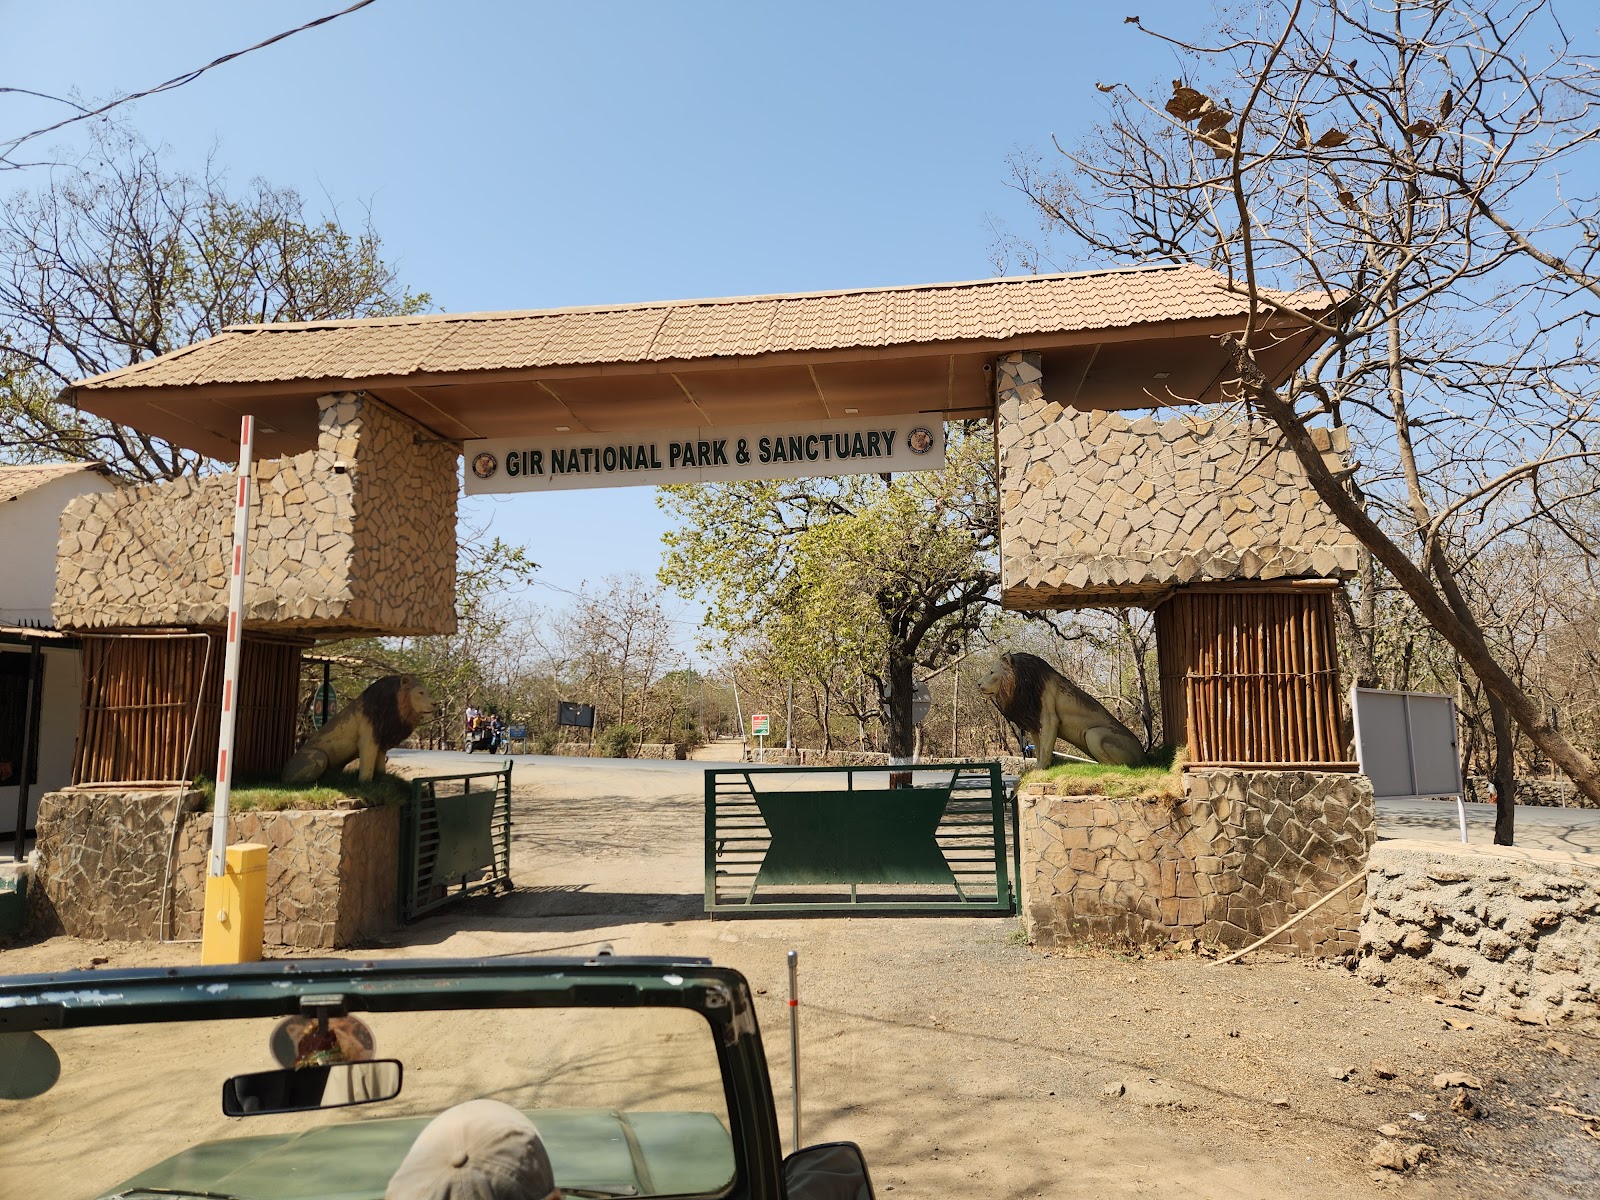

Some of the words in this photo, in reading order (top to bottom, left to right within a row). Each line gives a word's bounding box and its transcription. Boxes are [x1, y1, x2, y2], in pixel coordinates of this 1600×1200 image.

[505, 450, 545, 477] GIR
[550, 444, 663, 475] NATIONAL
[668, 439, 730, 468] PARK
[735, 438, 752, 465] &
[757, 430, 897, 464] SANCTUARY
